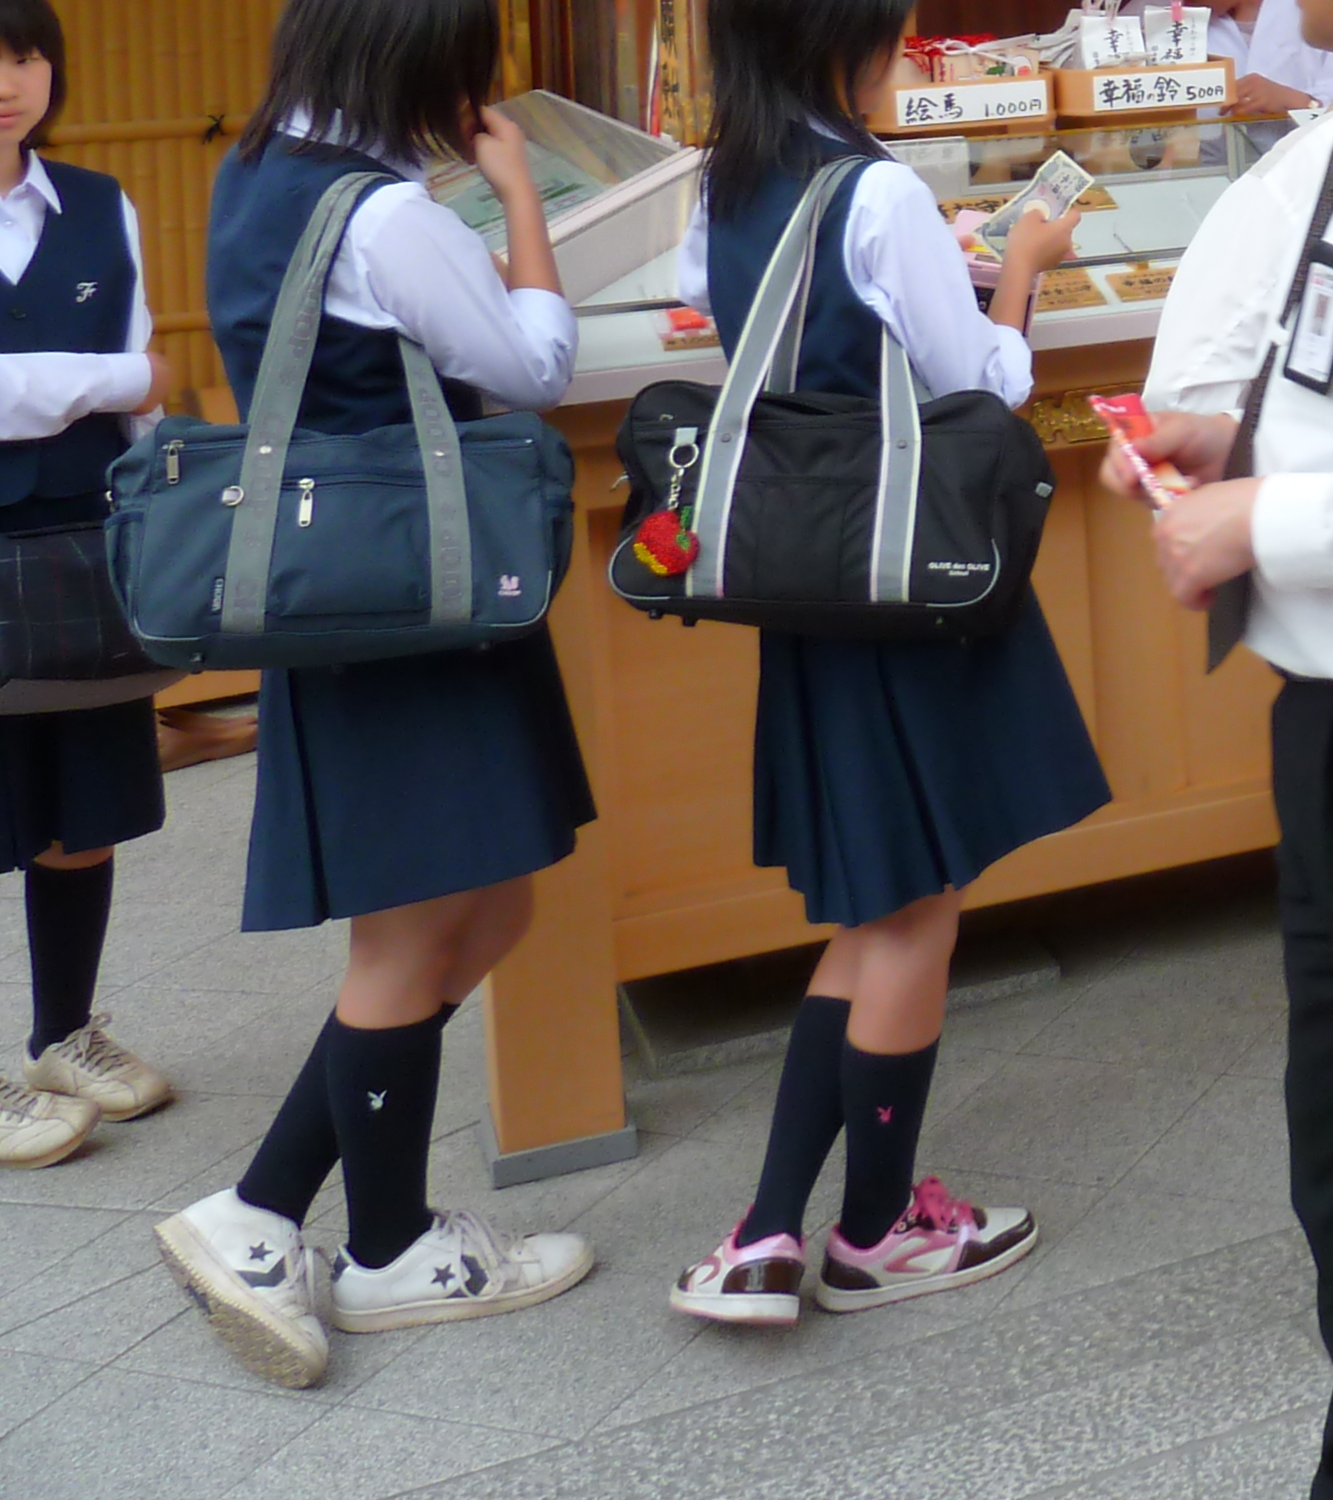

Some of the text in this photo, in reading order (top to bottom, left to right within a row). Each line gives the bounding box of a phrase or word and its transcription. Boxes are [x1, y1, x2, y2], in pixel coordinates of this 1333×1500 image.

[1104, 29, 1124, 59] 幸
[1098, 75, 1182, 104] 幸福の鈴
[904, 92, 965, 122] 絵馬
